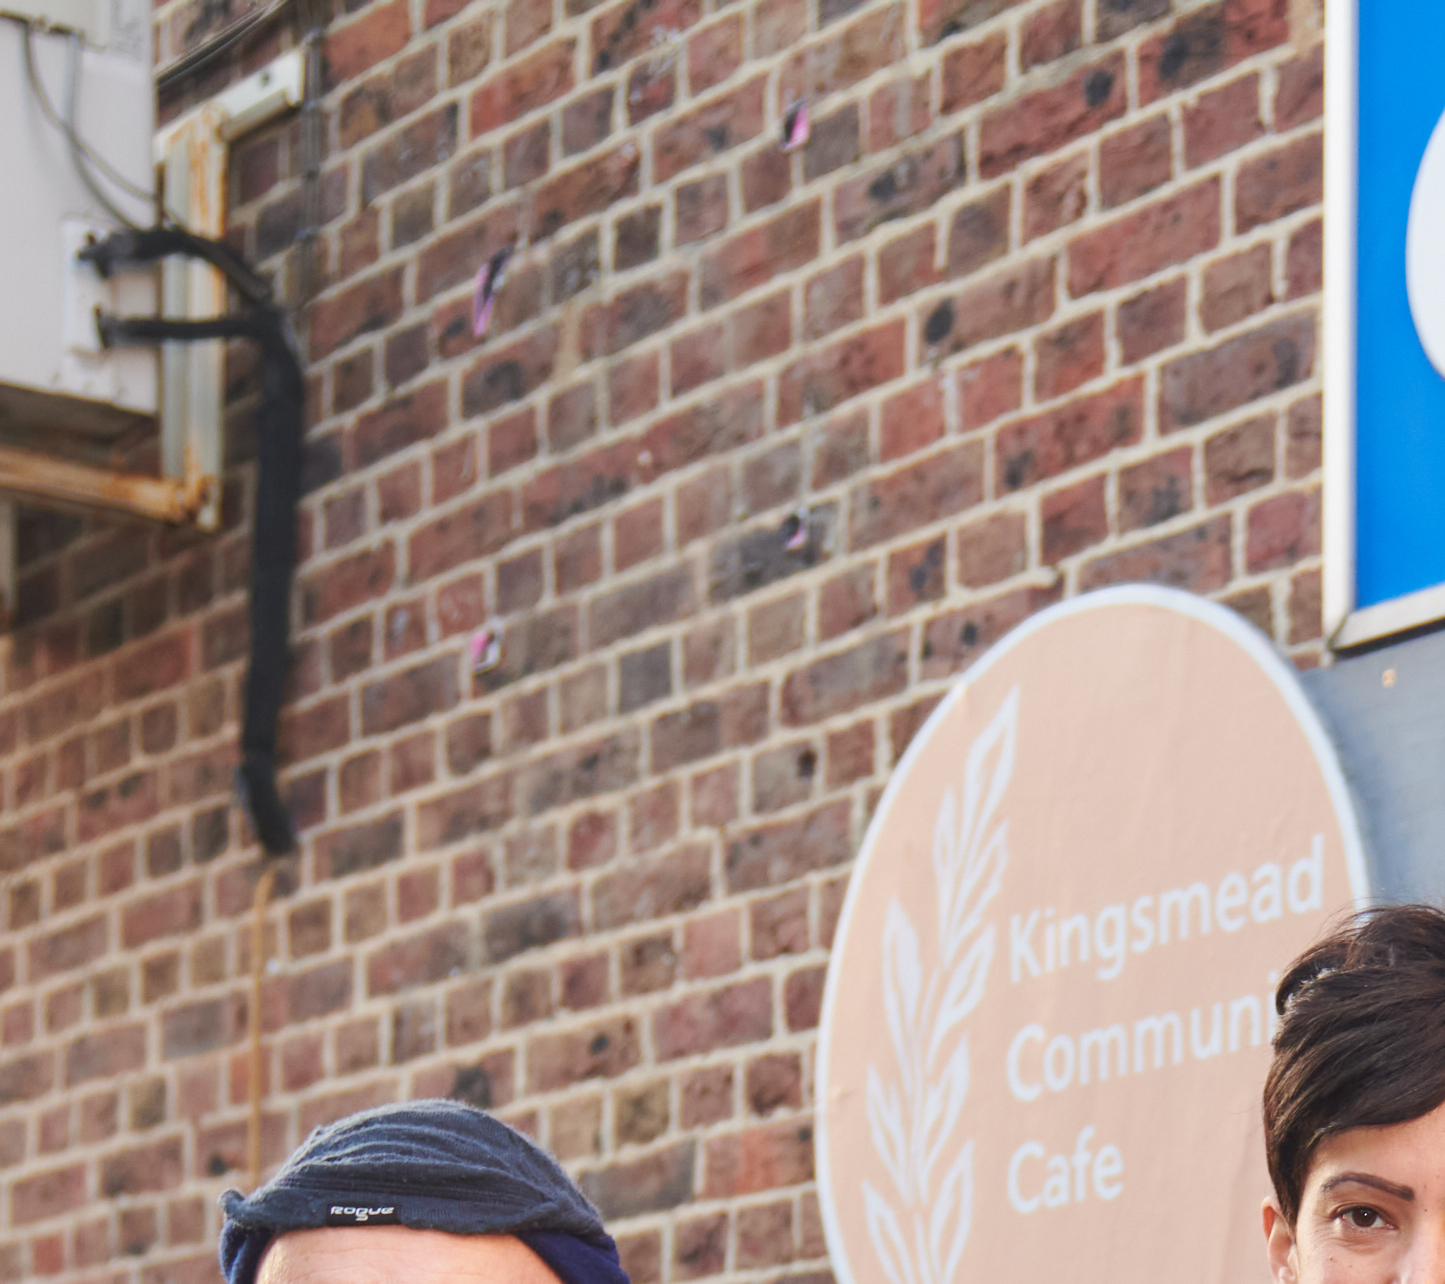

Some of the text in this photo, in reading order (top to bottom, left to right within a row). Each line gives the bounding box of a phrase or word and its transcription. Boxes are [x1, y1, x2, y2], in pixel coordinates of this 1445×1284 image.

[1008, 832, 1324, 984] Kingsmead
[1006, 970, 1280, 1102] Communi
[1007, 1124, 1125, 1215] Cafe
